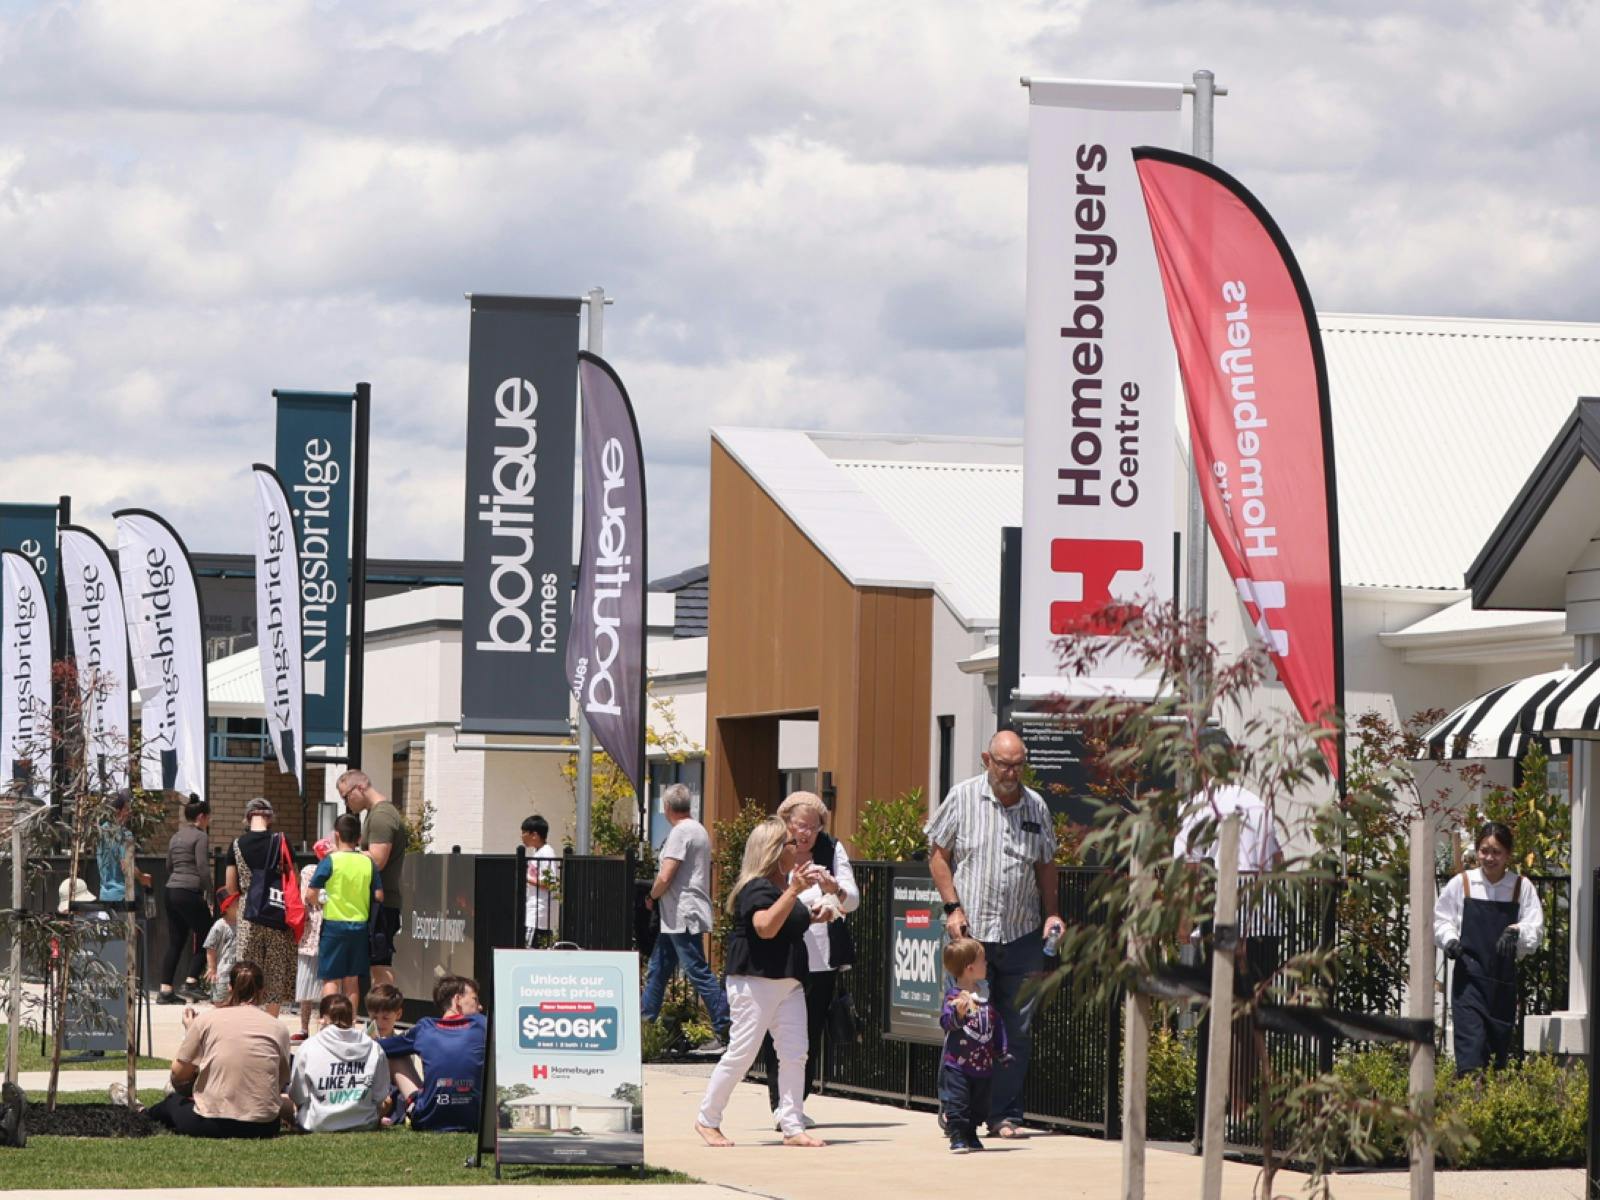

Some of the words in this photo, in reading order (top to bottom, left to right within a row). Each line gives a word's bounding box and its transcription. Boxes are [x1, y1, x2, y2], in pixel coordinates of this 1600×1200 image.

[1057, 143, 1118, 506] Homebuyers
[1110, 381, 1140, 508] Centre
[293, 438, 340, 697] Kingsbridge
[476, 377, 539, 653] boutique
[81, 564, 107, 788] igbridge
[141, 547, 179, 789] Kingsbridge
[264, 511, 296, 773] Kingsbridge
[536, 573, 558, 653] homes
[520, 986, 567, 998] lowest
[570, 986, 615, 999] prices
[530, 974, 578, 985] Unlock
[580, 976, 605, 986] our
[317, 1076, 346, 1090] LIKE
[347, 1075, 356, 1089] A
[330, 1061, 366, 1075] TRAIN
[551, 1065, 605, 1076] Homebuyers
